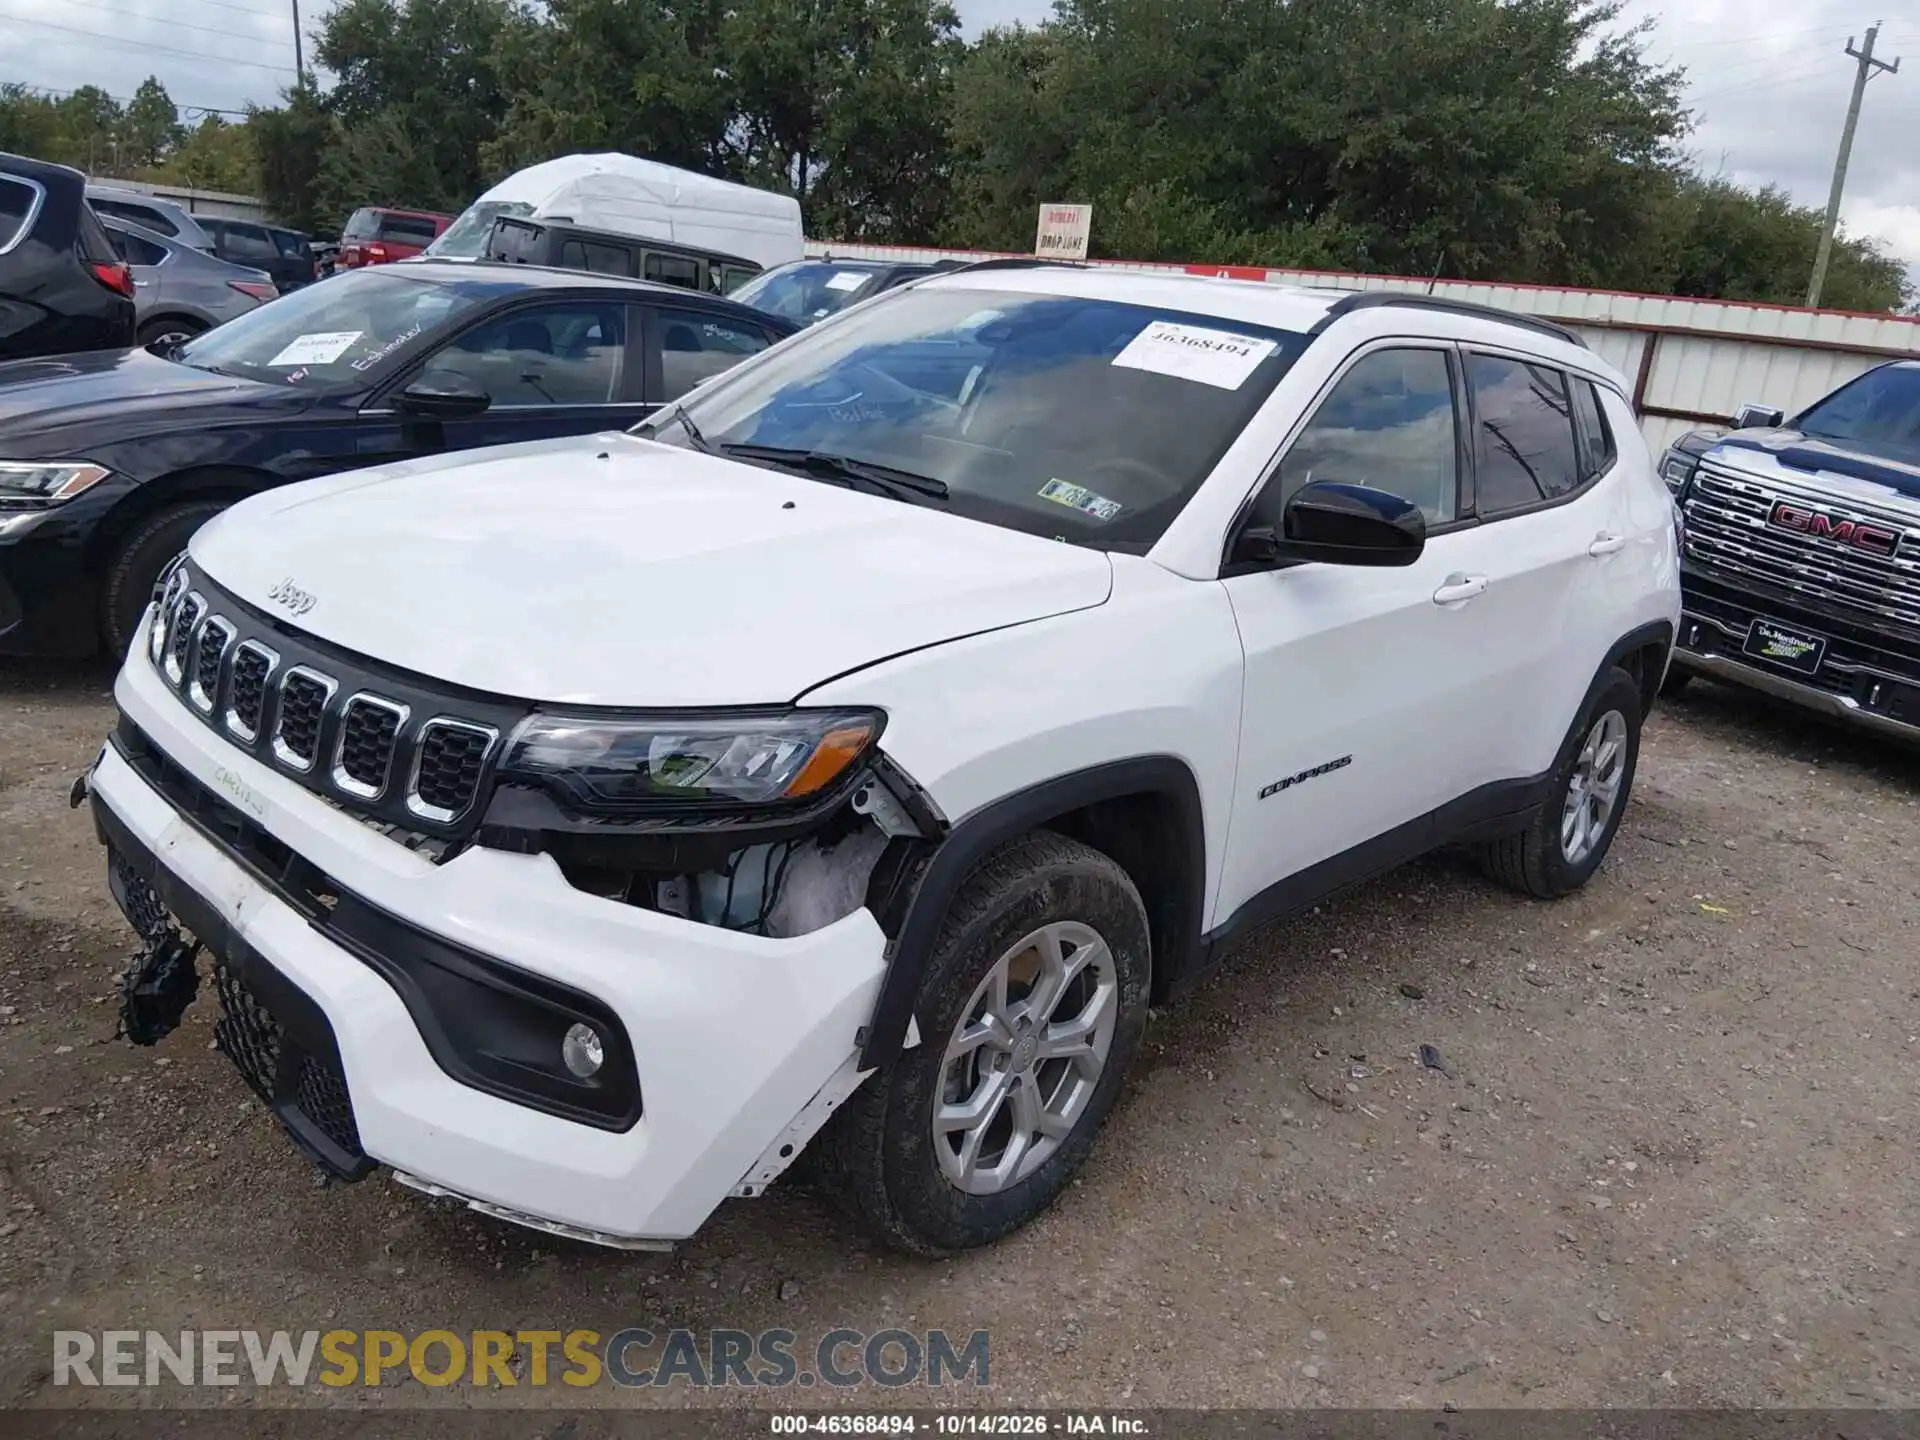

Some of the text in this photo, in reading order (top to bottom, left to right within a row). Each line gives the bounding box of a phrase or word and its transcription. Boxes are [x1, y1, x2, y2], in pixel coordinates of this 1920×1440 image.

[1775, 504, 1894, 555] GMC
[267, 576, 318, 618] Jeep
[1258, 754, 1353, 800] COMPASS
